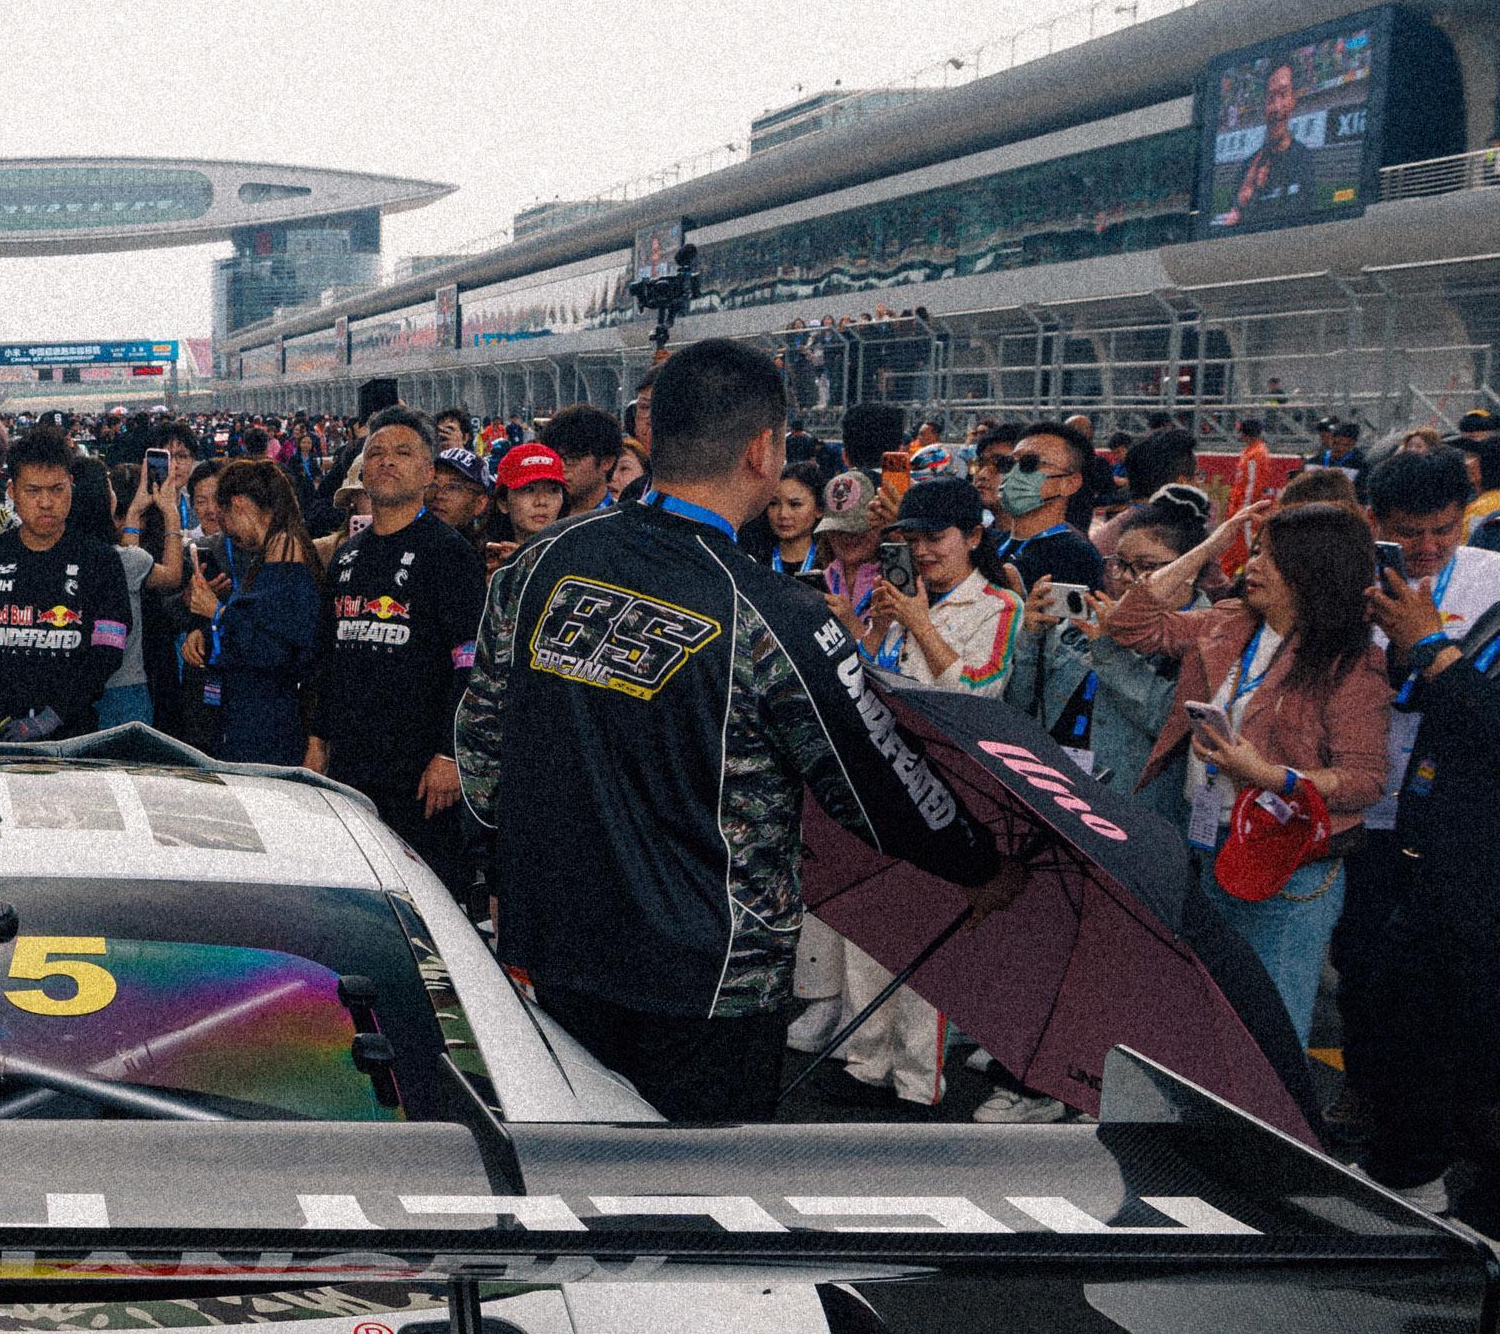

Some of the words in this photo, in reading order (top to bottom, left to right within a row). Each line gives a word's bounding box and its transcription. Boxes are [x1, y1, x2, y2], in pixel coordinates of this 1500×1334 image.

[11, 605, 33, 627] Bull
[534, 580, 712, 684] 85
[534, 649, 614, 686] RACING
[836, 652, 957, 831] UNDEFEATED
[977, 740, 1128, 841] uno
